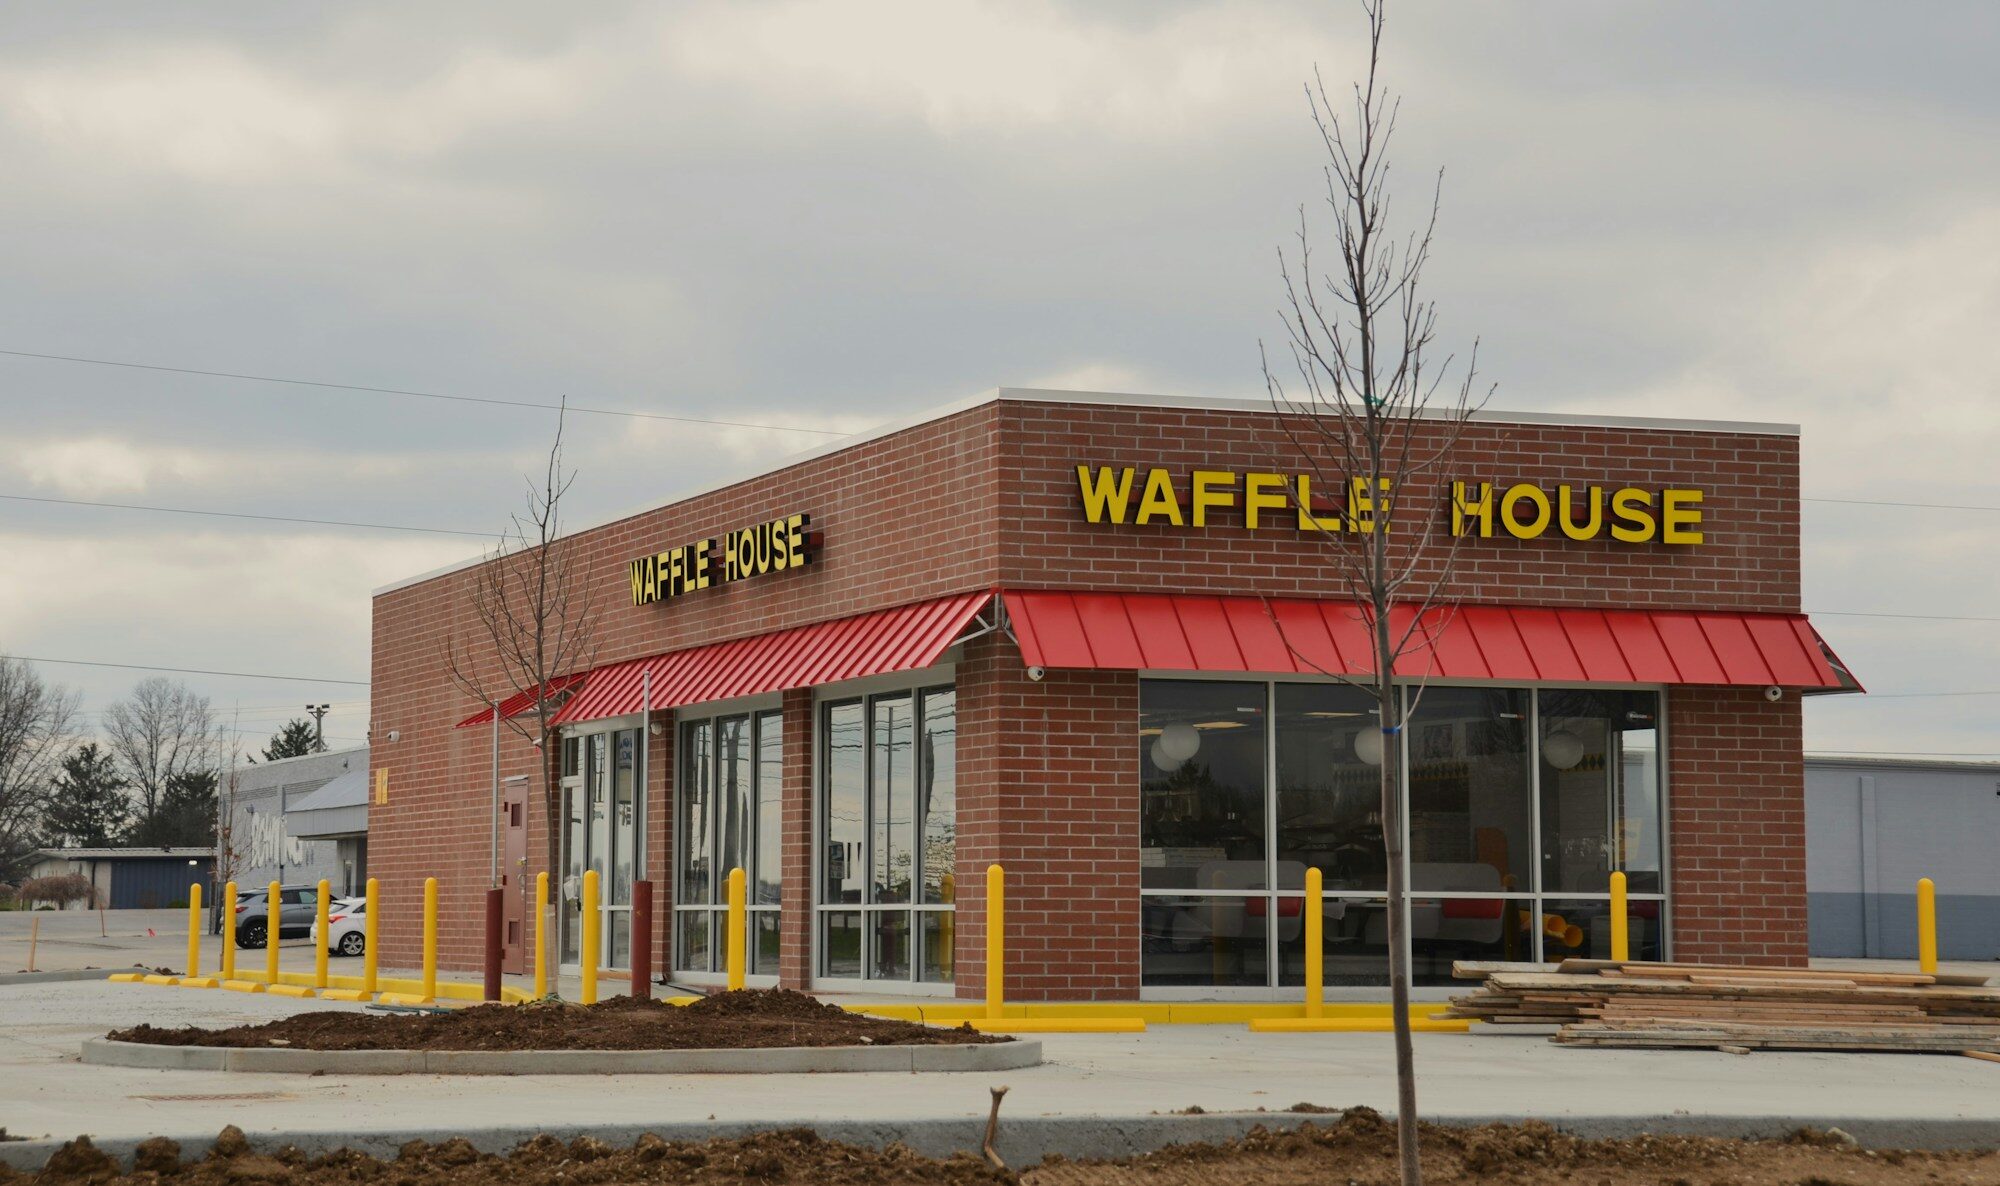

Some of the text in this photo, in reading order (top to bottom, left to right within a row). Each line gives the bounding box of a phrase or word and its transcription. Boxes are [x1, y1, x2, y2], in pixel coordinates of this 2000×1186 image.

[1076, 465, 1704, 544] WAFFLE HOUSE
[630, 514, 805, 606] WAFFLE HOUSE
